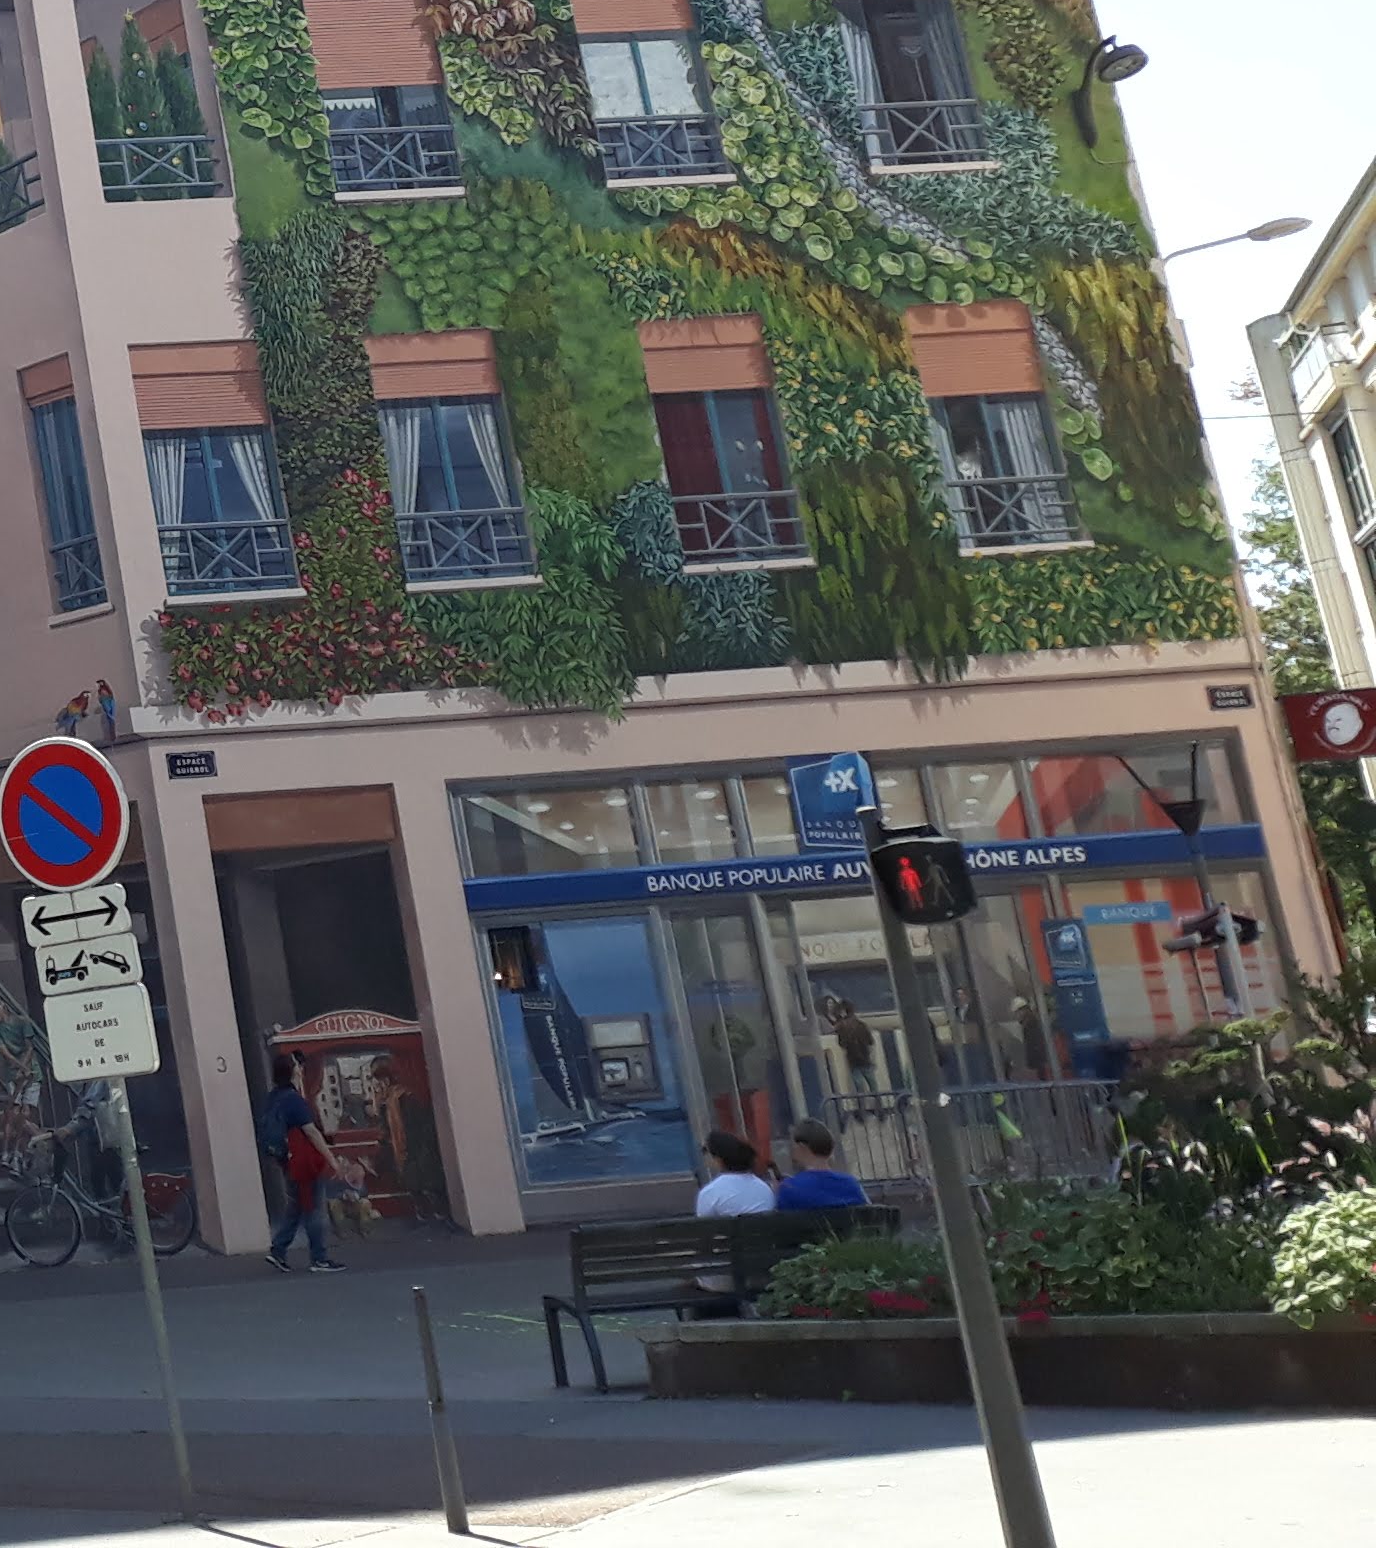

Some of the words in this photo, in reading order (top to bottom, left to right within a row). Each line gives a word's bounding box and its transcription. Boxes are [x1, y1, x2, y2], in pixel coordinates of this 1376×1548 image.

[176, 757, 206, 766] ESPACE
[806, 820, 857, 829] BANQU
[808, 830, 862, 840] POPULAIR
[646, 871, 725, 893] BANQUE
[728, 865, 825, 886] POPULAIRE
[966, 848, 1020, 868] HÔNE
[1025, 846, 1087, 865] ALPES
[83, 1001, 105, 1012] SAUF
[76, 1018, 119, 1031] AUTOCARS
[314, 1013, 387, 1035] GUIGNOL
[94, 1038, 106, 1048] DE
[216, 1056, 227, 1073] 3
